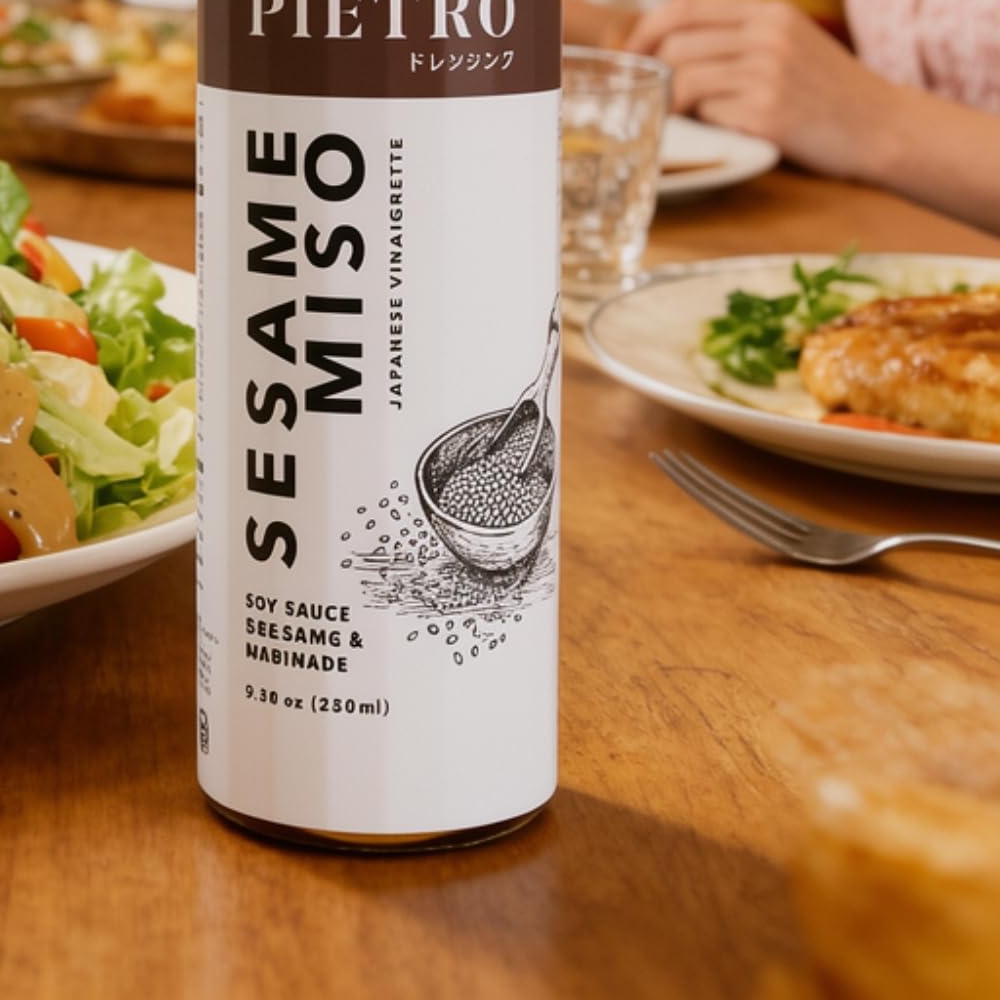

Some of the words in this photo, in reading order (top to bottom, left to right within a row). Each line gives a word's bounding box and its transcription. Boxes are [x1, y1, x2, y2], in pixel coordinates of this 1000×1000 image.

[389, 138, 403, 289] VINAIGRETTE
[303, 133, 366, 415] MISO
[245, 129, 298, 569] SESAME
[389, 298, 403, 410] JAPANESE
[245, 592, 278, 614] SOY
[285, 600, 351, 622] SAUCE
[349, 630, 364, 649] &
[284, 697, 304, 710] oz
